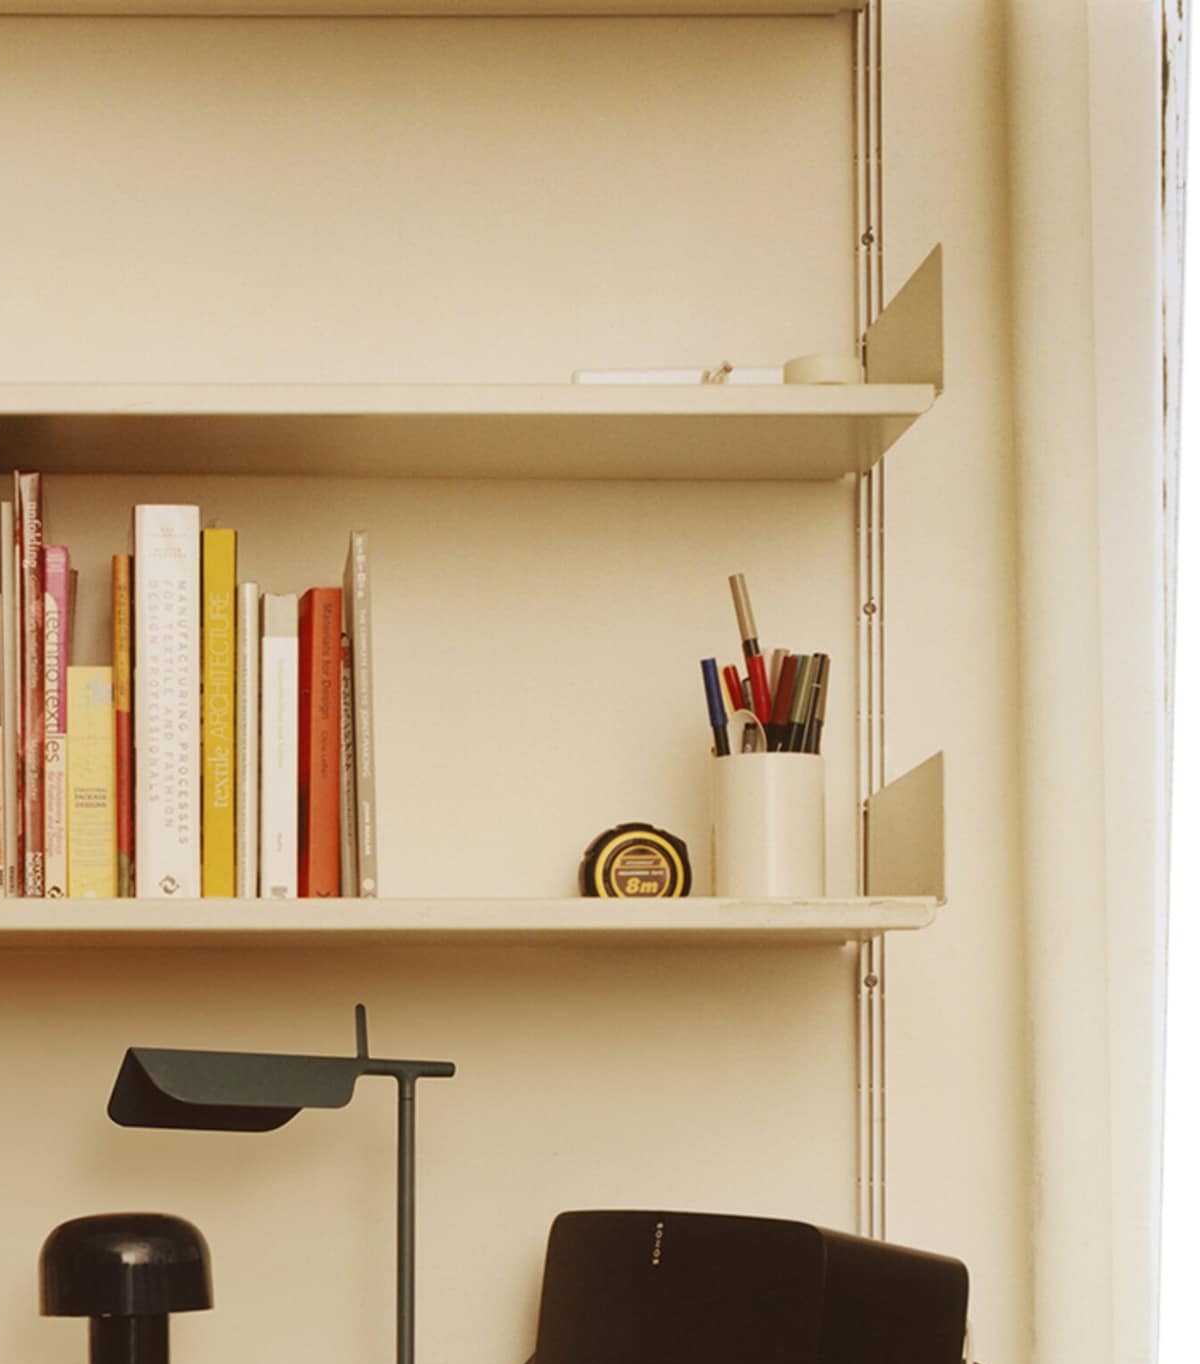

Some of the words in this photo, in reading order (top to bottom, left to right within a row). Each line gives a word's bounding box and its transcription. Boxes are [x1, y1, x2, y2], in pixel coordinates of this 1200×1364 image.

[25, 501, 42, 568] unfolding
[148, 579, 159, 645] DESIGN
[163, 580, 174, 612] FOR
[45, 609, 65, 682] techno
[163, 622, 175, 697] TEXTILE
[177, 579, 188, 732] MANUFACTURING
[321, 603, 333, 657] Materials
[208, 591, 230, 740] ARCHITECTURE
[321, 659, 332, 677] for
[45, 687, 66, 763] textiles
[148, 654, 160, 803] PROFESSIONALS
[164, 706, 175, 741] AND
[319, 679, 332, 721] Design
[164, 751, 175, 829] FASHION
[177, 741, 188, 845] PROCESSES
[209, 745, 231, 808] textile
[626, 876, 658, 894] 8m
[652, 1222, 665, 1265] SONOS
